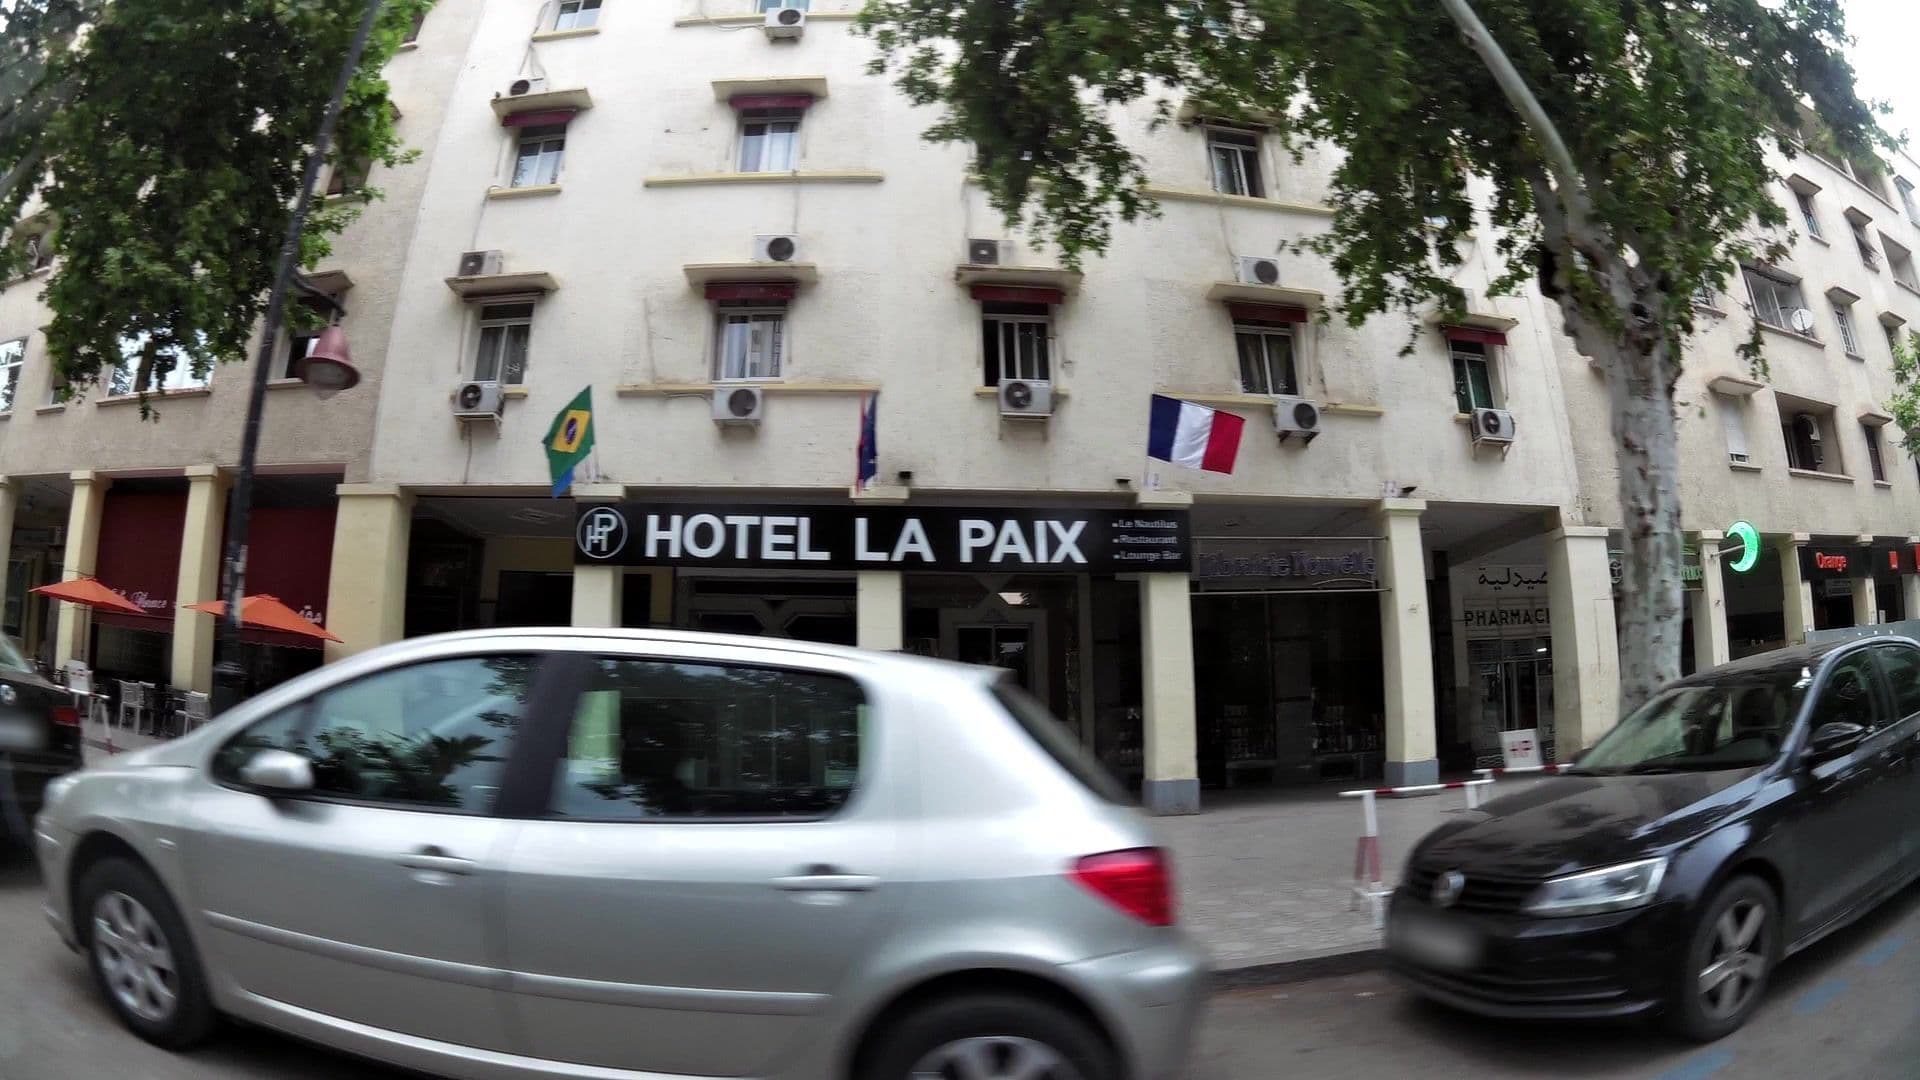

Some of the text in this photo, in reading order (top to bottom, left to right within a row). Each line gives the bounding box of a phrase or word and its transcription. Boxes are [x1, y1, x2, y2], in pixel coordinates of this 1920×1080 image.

[1118, 519, 1133, 528] Le
[645, 513, 1088, 563] HOTEL LA PAIX
[1119, 534, 1178, 544] Restaurant
[1119, 550, 1182, 562] Lounge Bar
[1815, 551, 1848, 573] Orange
[1463, 607, 1550, 627] PHARMACI
